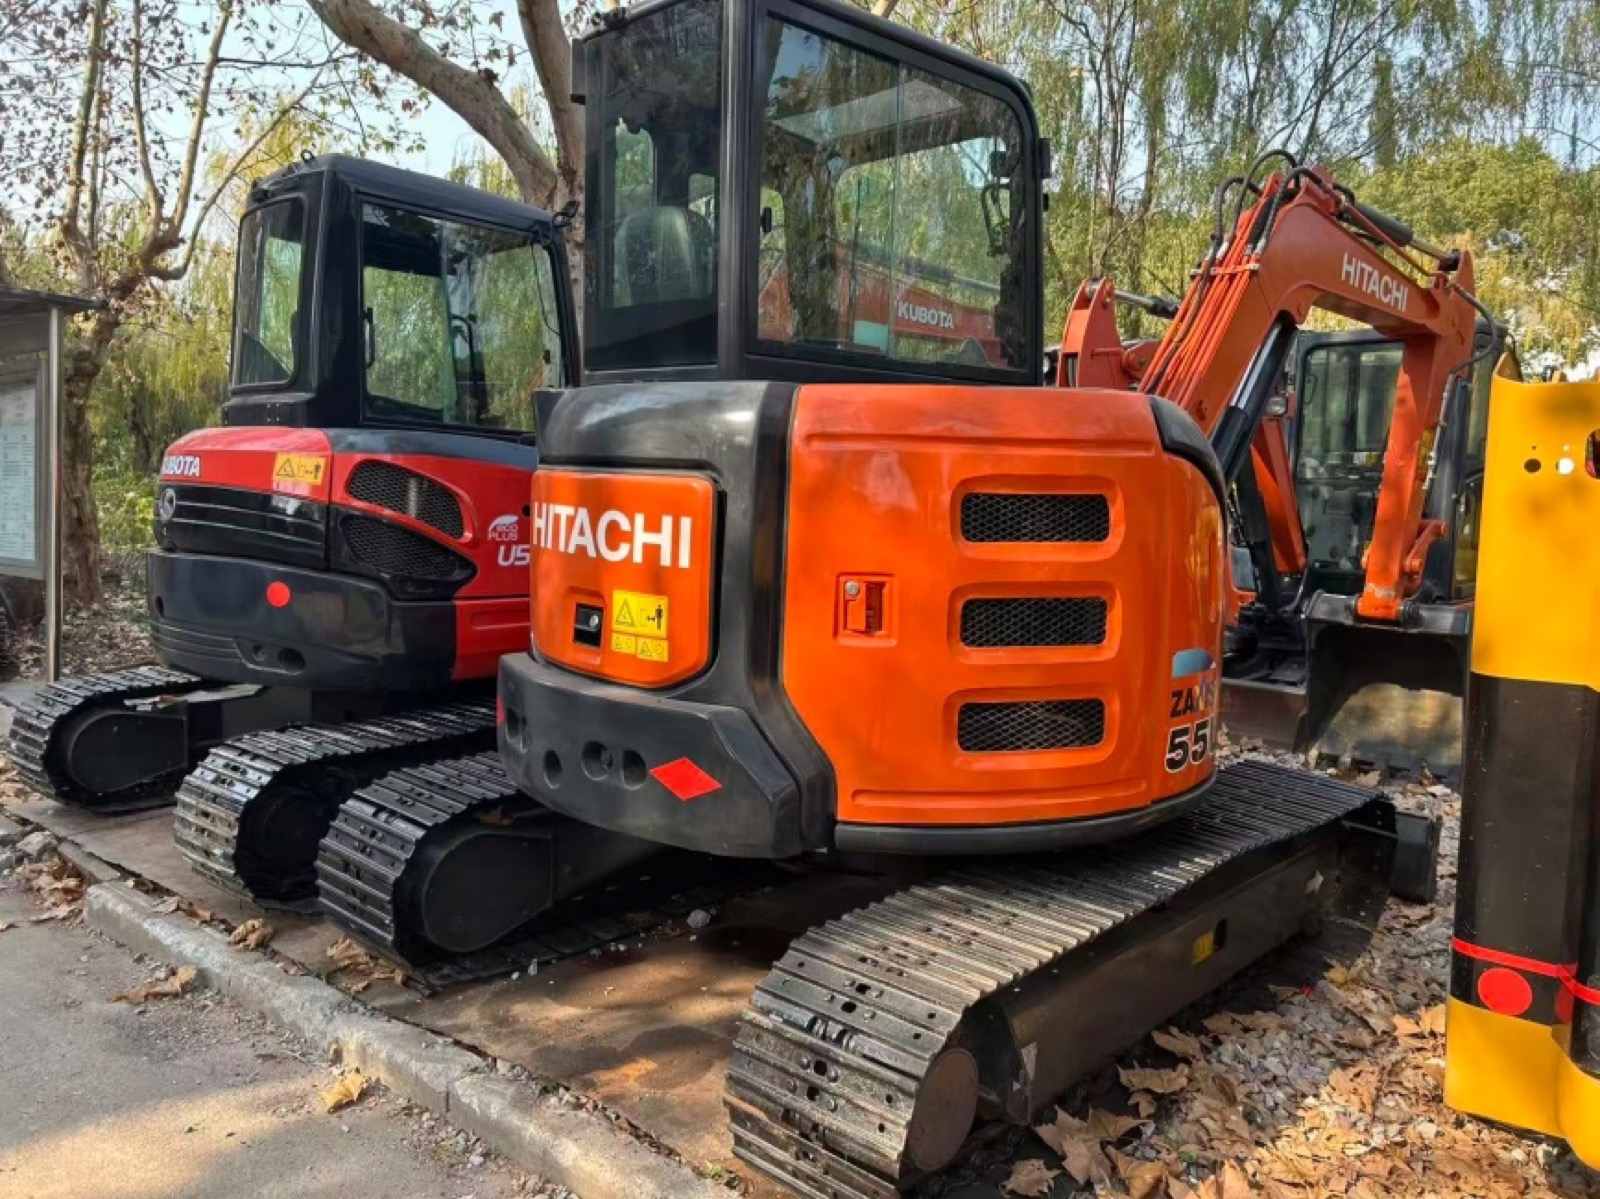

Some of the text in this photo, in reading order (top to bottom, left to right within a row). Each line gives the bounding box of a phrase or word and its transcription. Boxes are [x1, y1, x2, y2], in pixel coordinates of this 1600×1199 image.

[1341, 252, 1408, 312] HITACHI
[898, 302, 954, 329] KUBOTA
[163, 455, 200, 476] UBOTA
[533, 501, 691, 568] HITACHI
